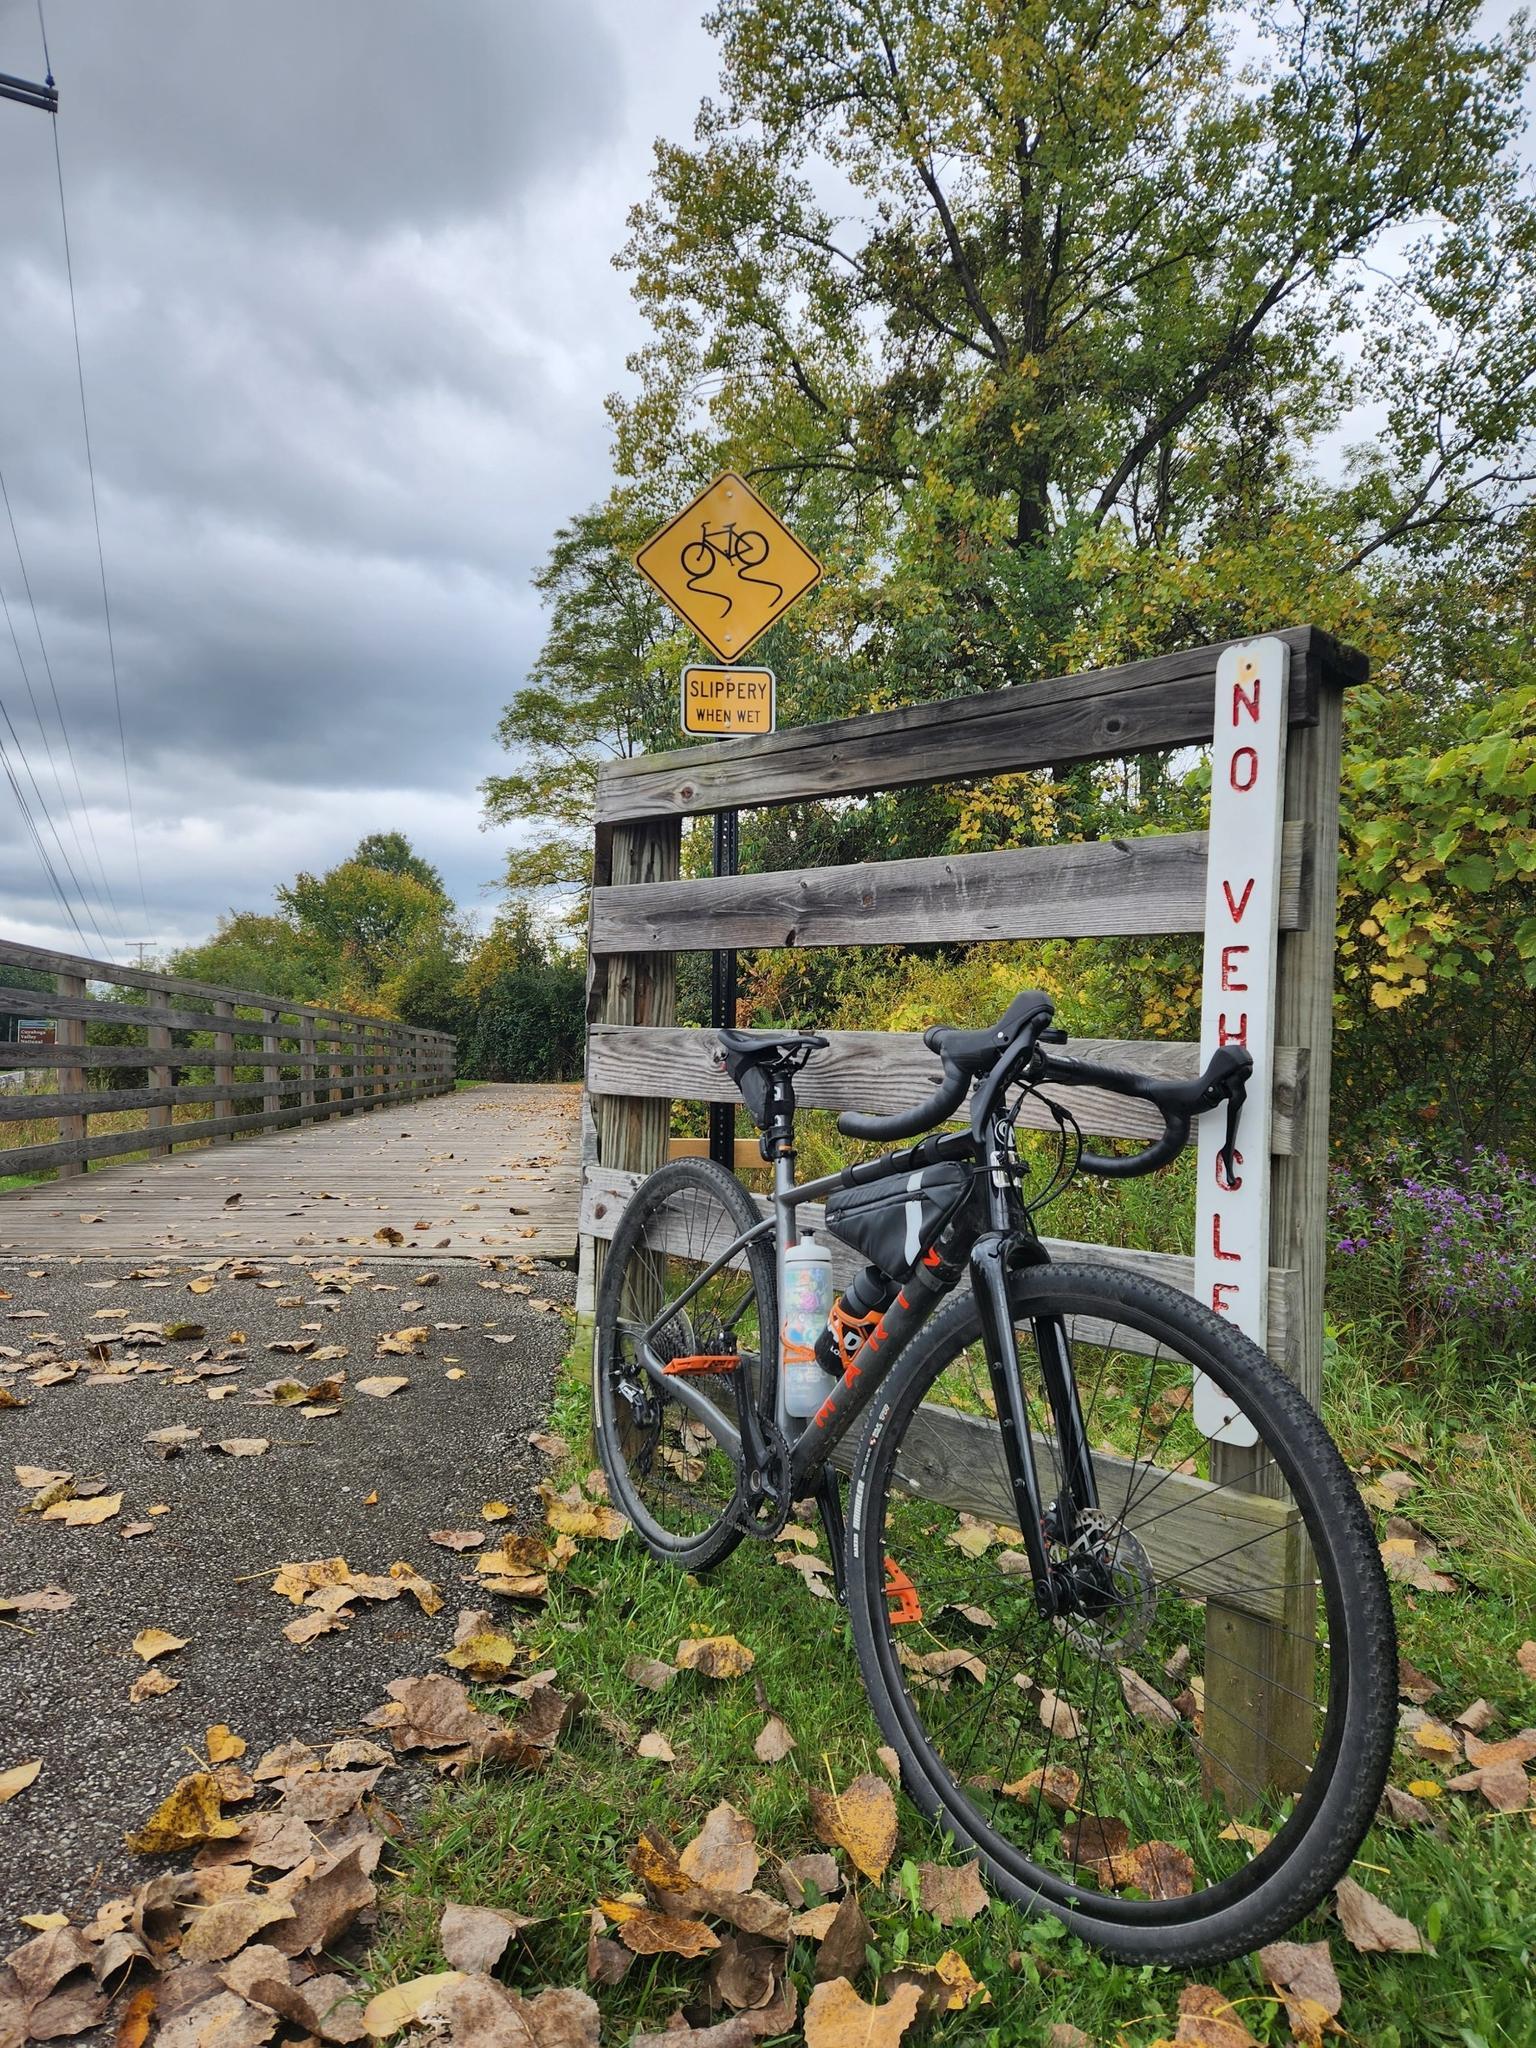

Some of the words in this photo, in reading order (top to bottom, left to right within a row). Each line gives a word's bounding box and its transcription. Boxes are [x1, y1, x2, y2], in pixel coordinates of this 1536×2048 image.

[690, 681, 767, 700] SLIPPERY
[696, 708, 731, 723] WHEN
[737, 709, 761, 723] WET
[1230, 678, 1261, 793] NO
[1212, 877, 1255, 1398] VEHCLE
